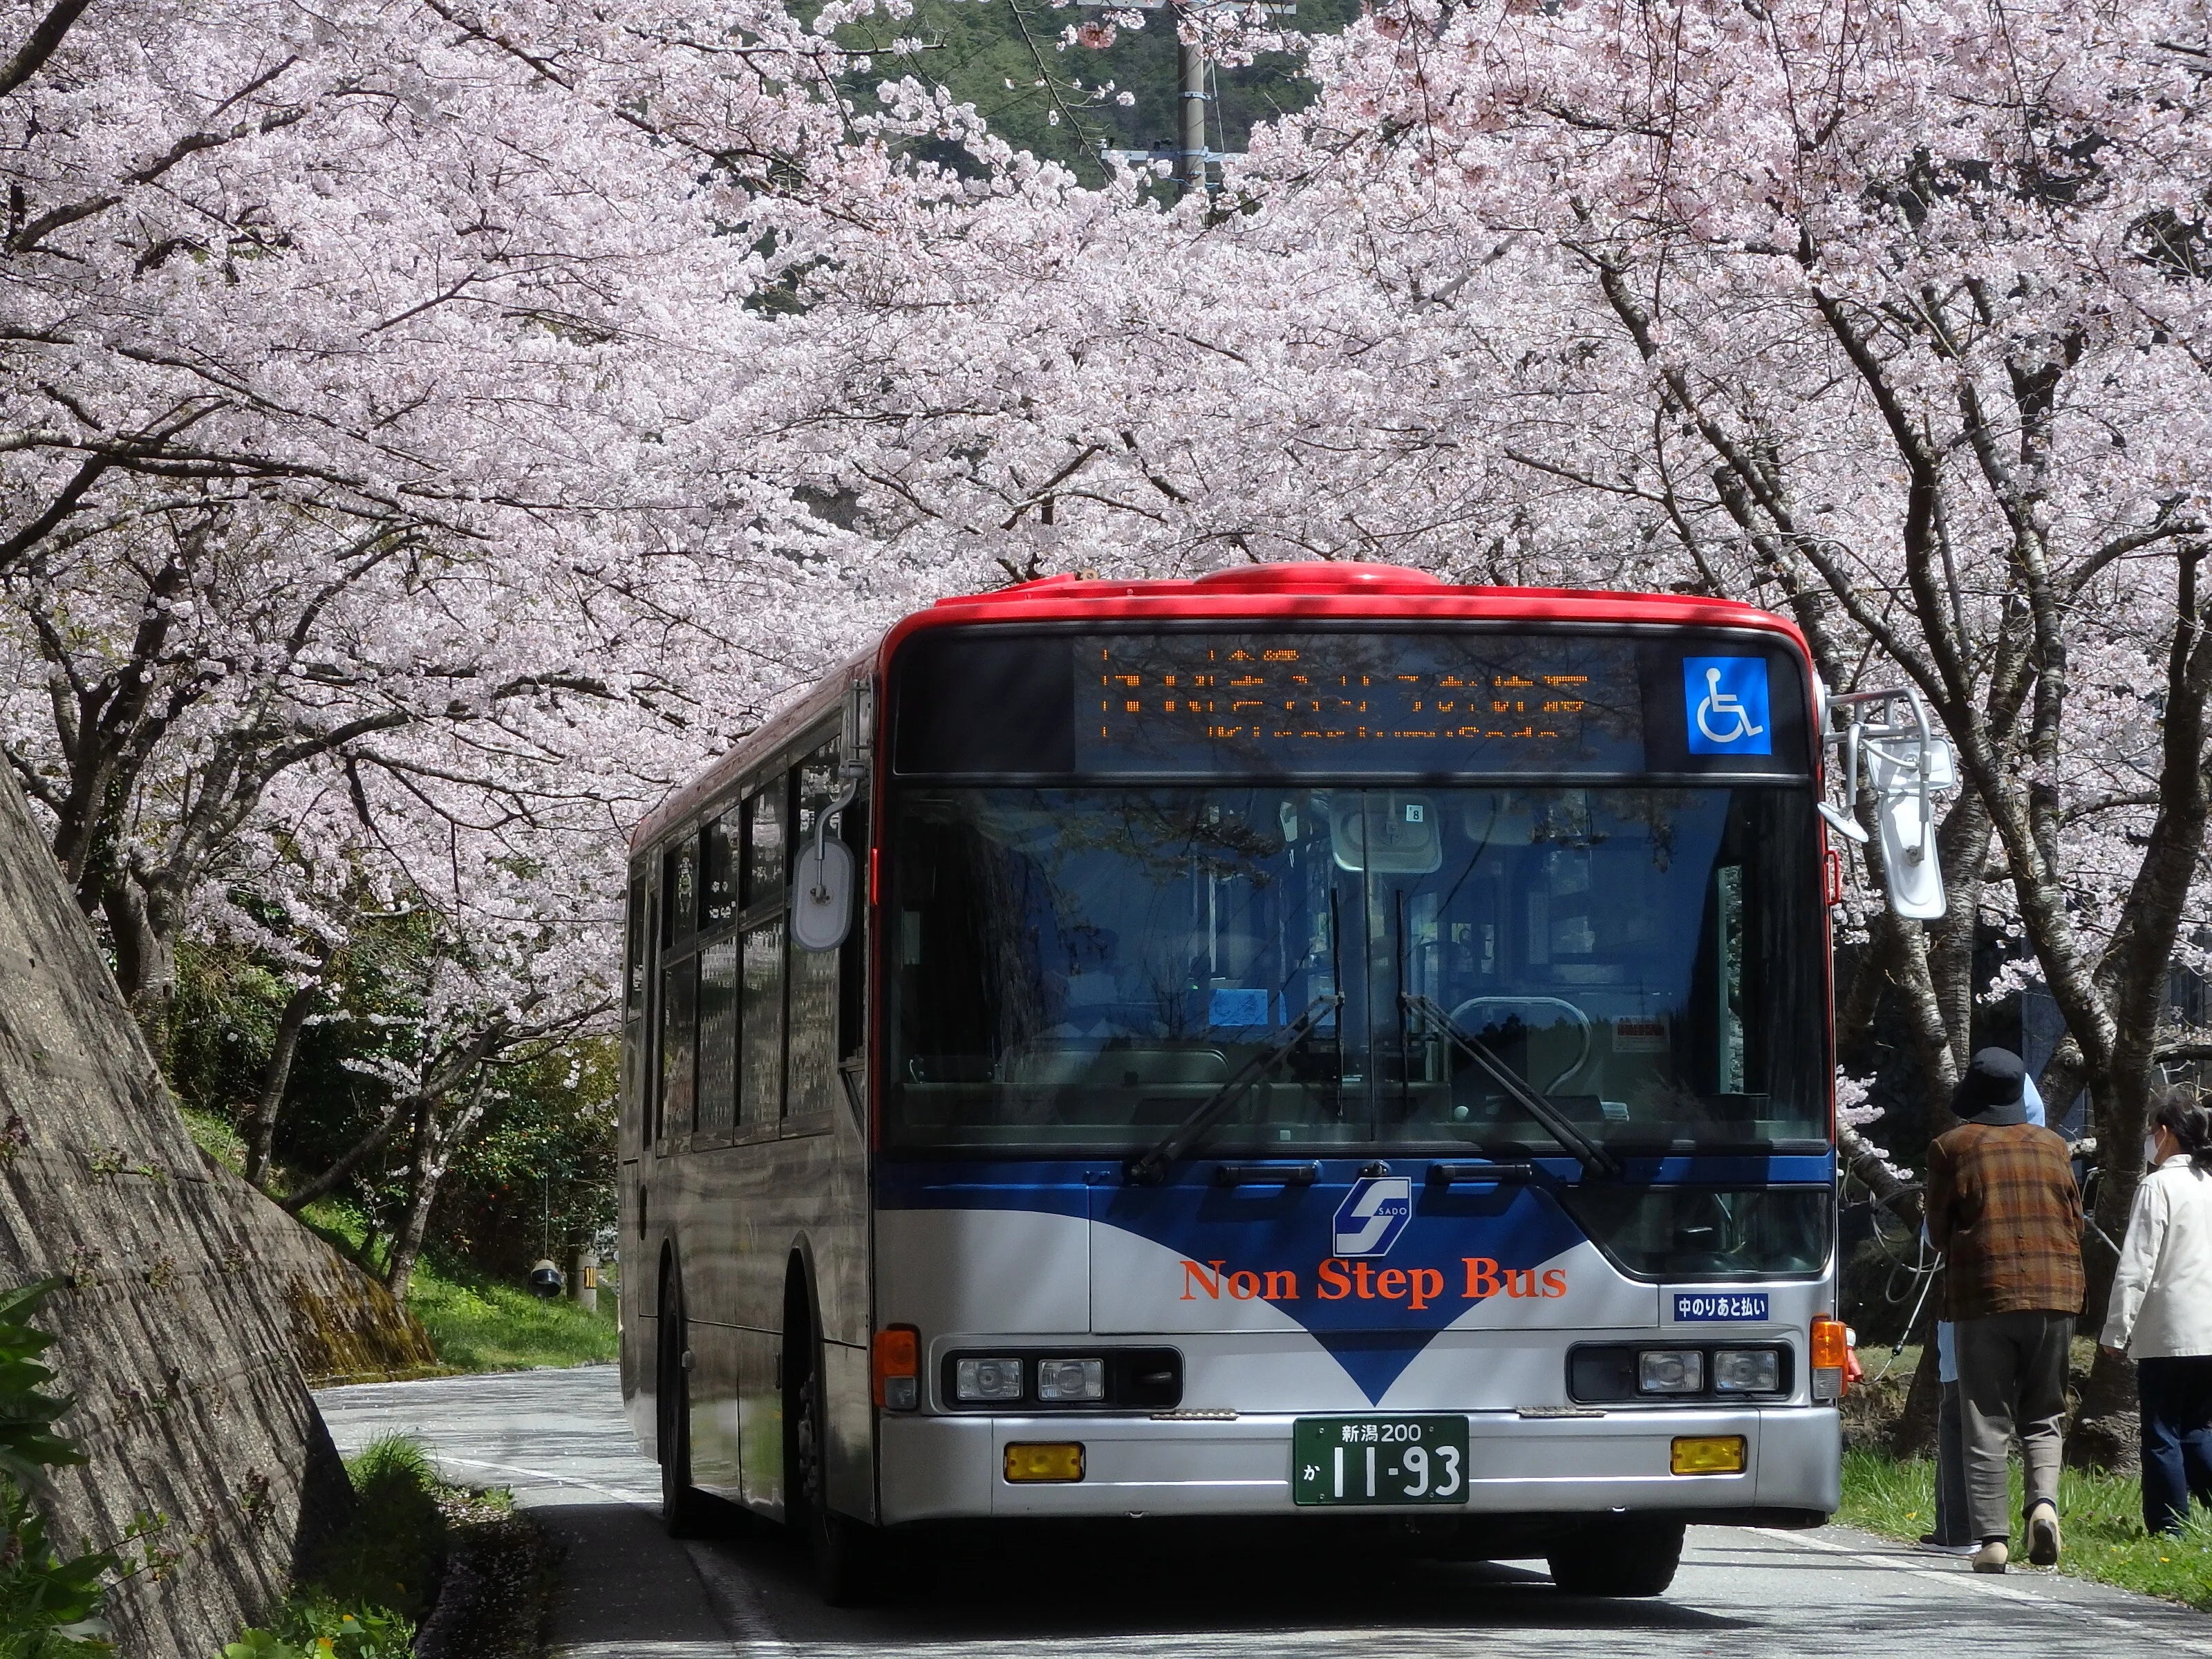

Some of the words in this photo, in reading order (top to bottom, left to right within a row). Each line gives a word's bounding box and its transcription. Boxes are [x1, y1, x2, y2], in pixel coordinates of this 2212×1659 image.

[1378, 1207, 1407, 1215] SADO
[1179, 1259, 1300, 1301] Non
[1317, 1257, 1445, 1310] Step
[1461, 1257, 1568, 1299] Bus
[1678, 1297, 1766, 1318] 中のりあと払い
[1303, 1463, 1320, 1481] か
[1333, 1445, 1461, 1498] 11-93
